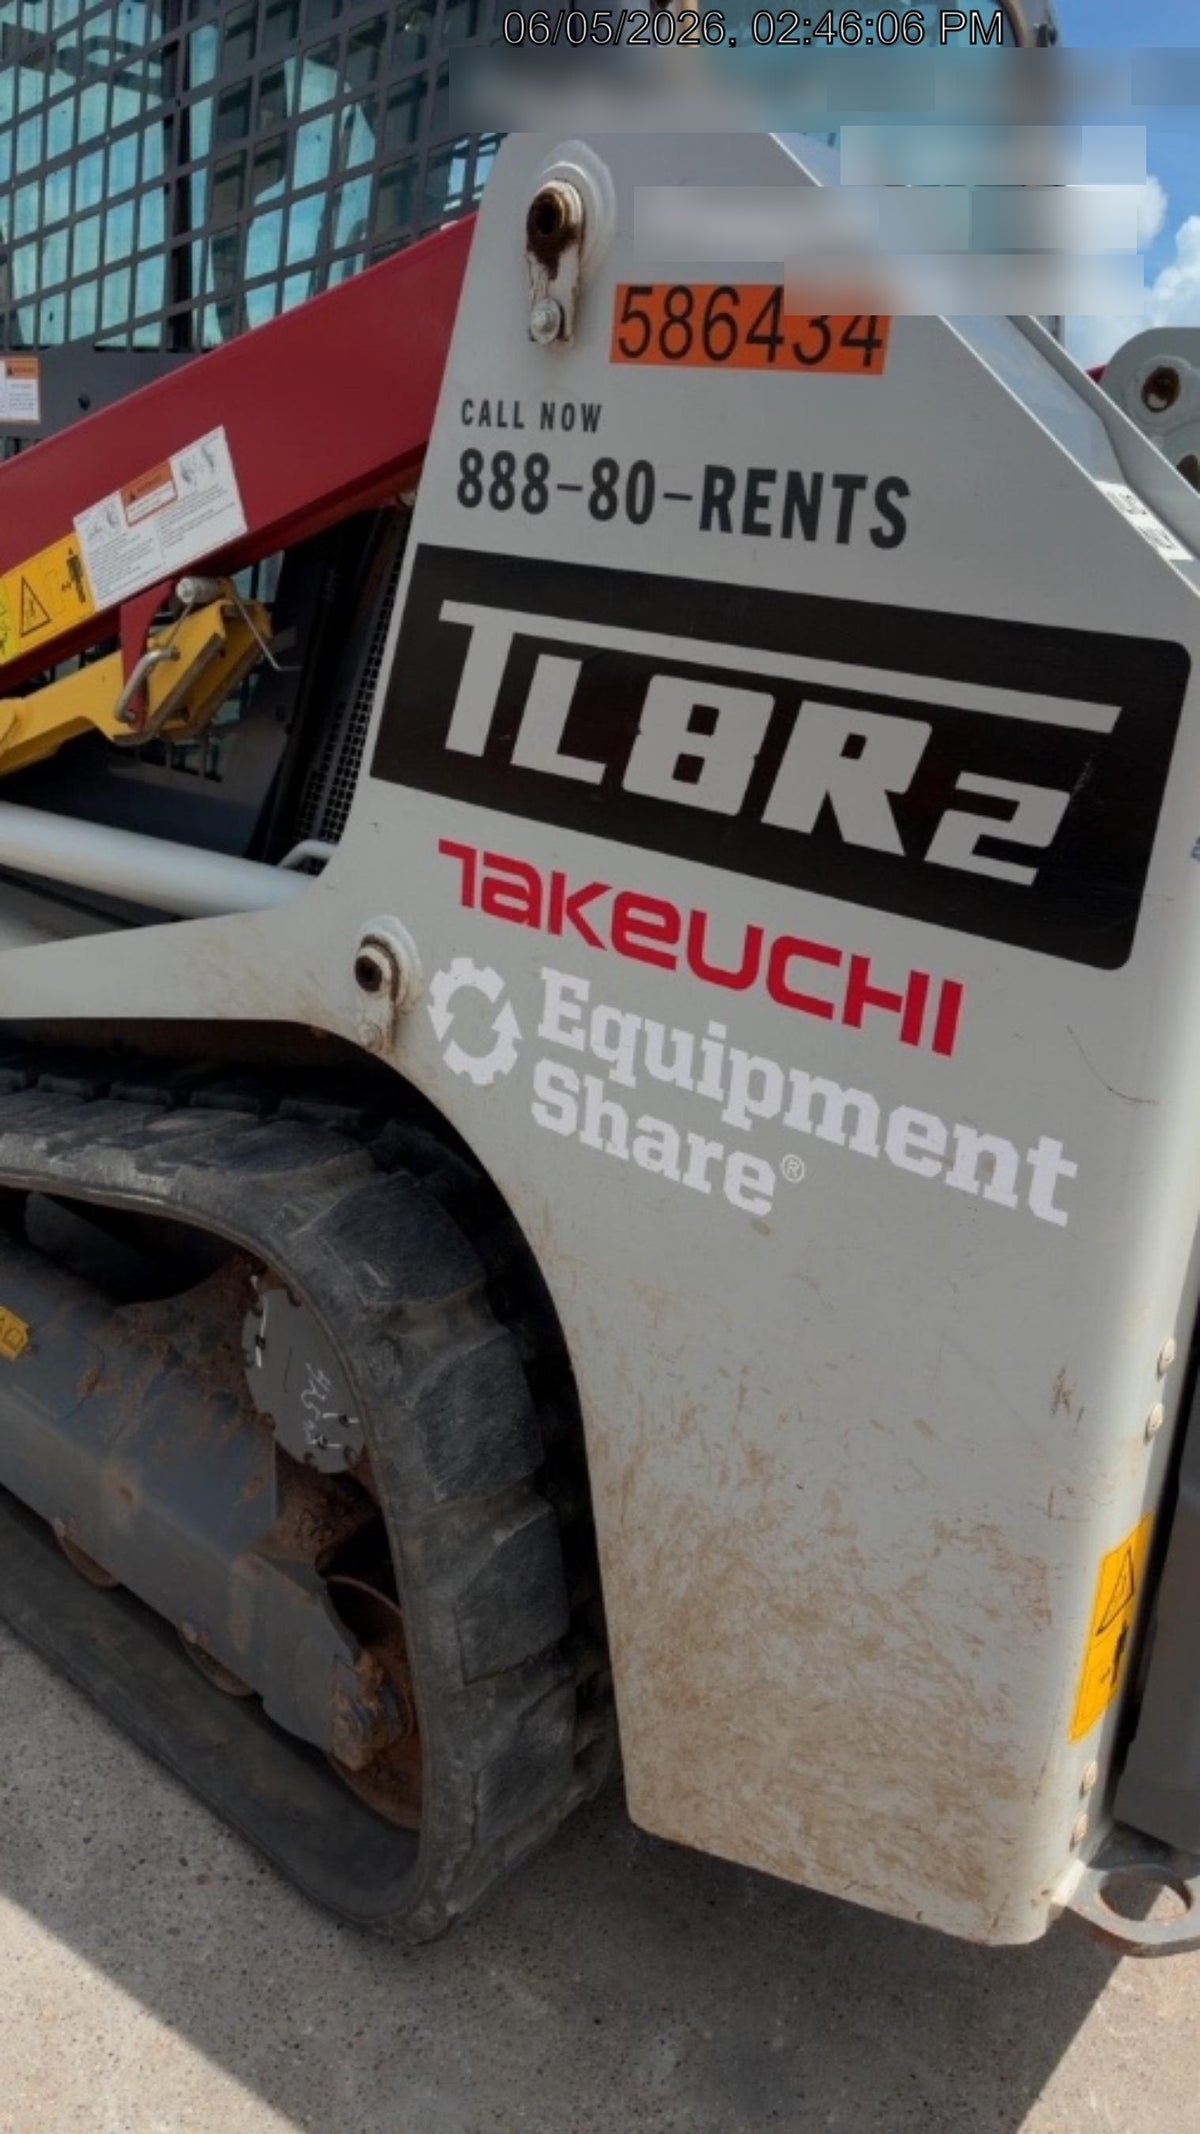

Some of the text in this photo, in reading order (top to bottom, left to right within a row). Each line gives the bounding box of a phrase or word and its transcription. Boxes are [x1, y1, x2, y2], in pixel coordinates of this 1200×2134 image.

[618, 285, 883, 368] 586434
[461, 398, 602, 433] CALL NOW
[457, 447, 911, 550] 888-80-RENTS
[438, 599, 1123, 887] TL8R2
[537, 966, 1079, 1227] Equipment
